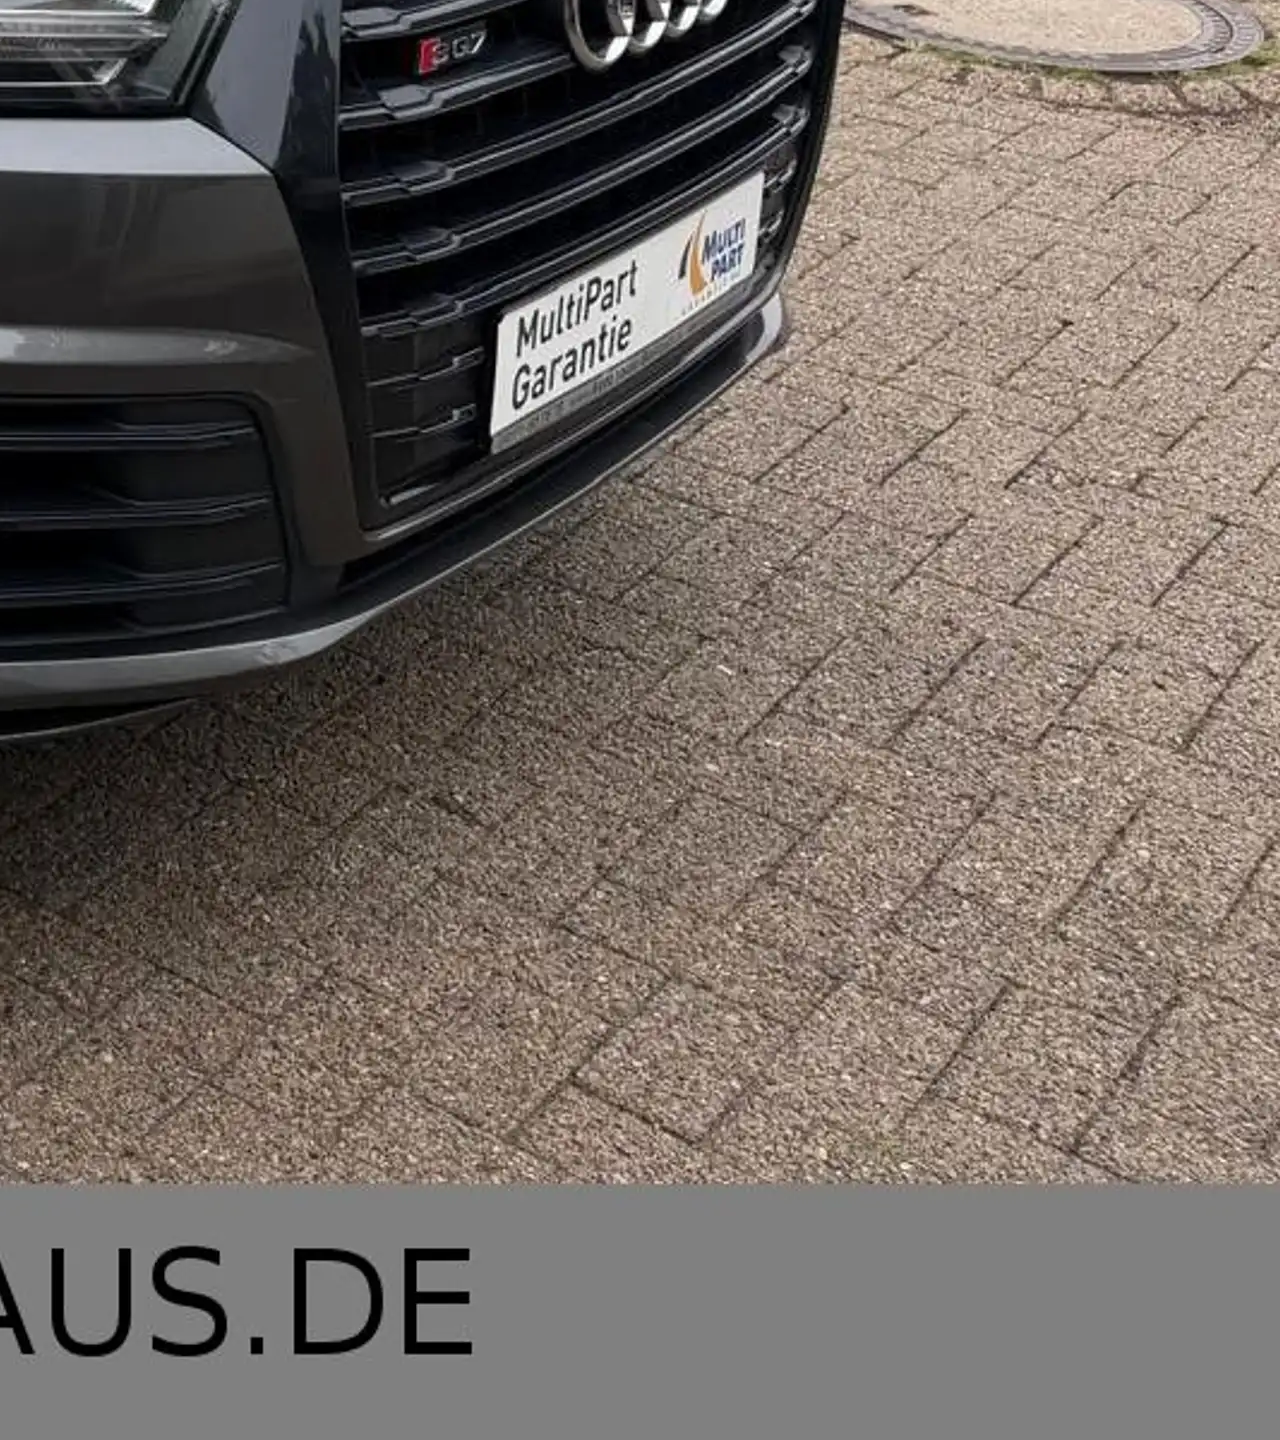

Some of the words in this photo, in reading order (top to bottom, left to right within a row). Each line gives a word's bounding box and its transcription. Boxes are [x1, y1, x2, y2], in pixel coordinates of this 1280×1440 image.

[418, 30, 488, 76] SQ7
[710, 243, 744, 281] PART
[515, 259, 639, 359] MultiPart
[511, 314, 633, 411] Garantie
